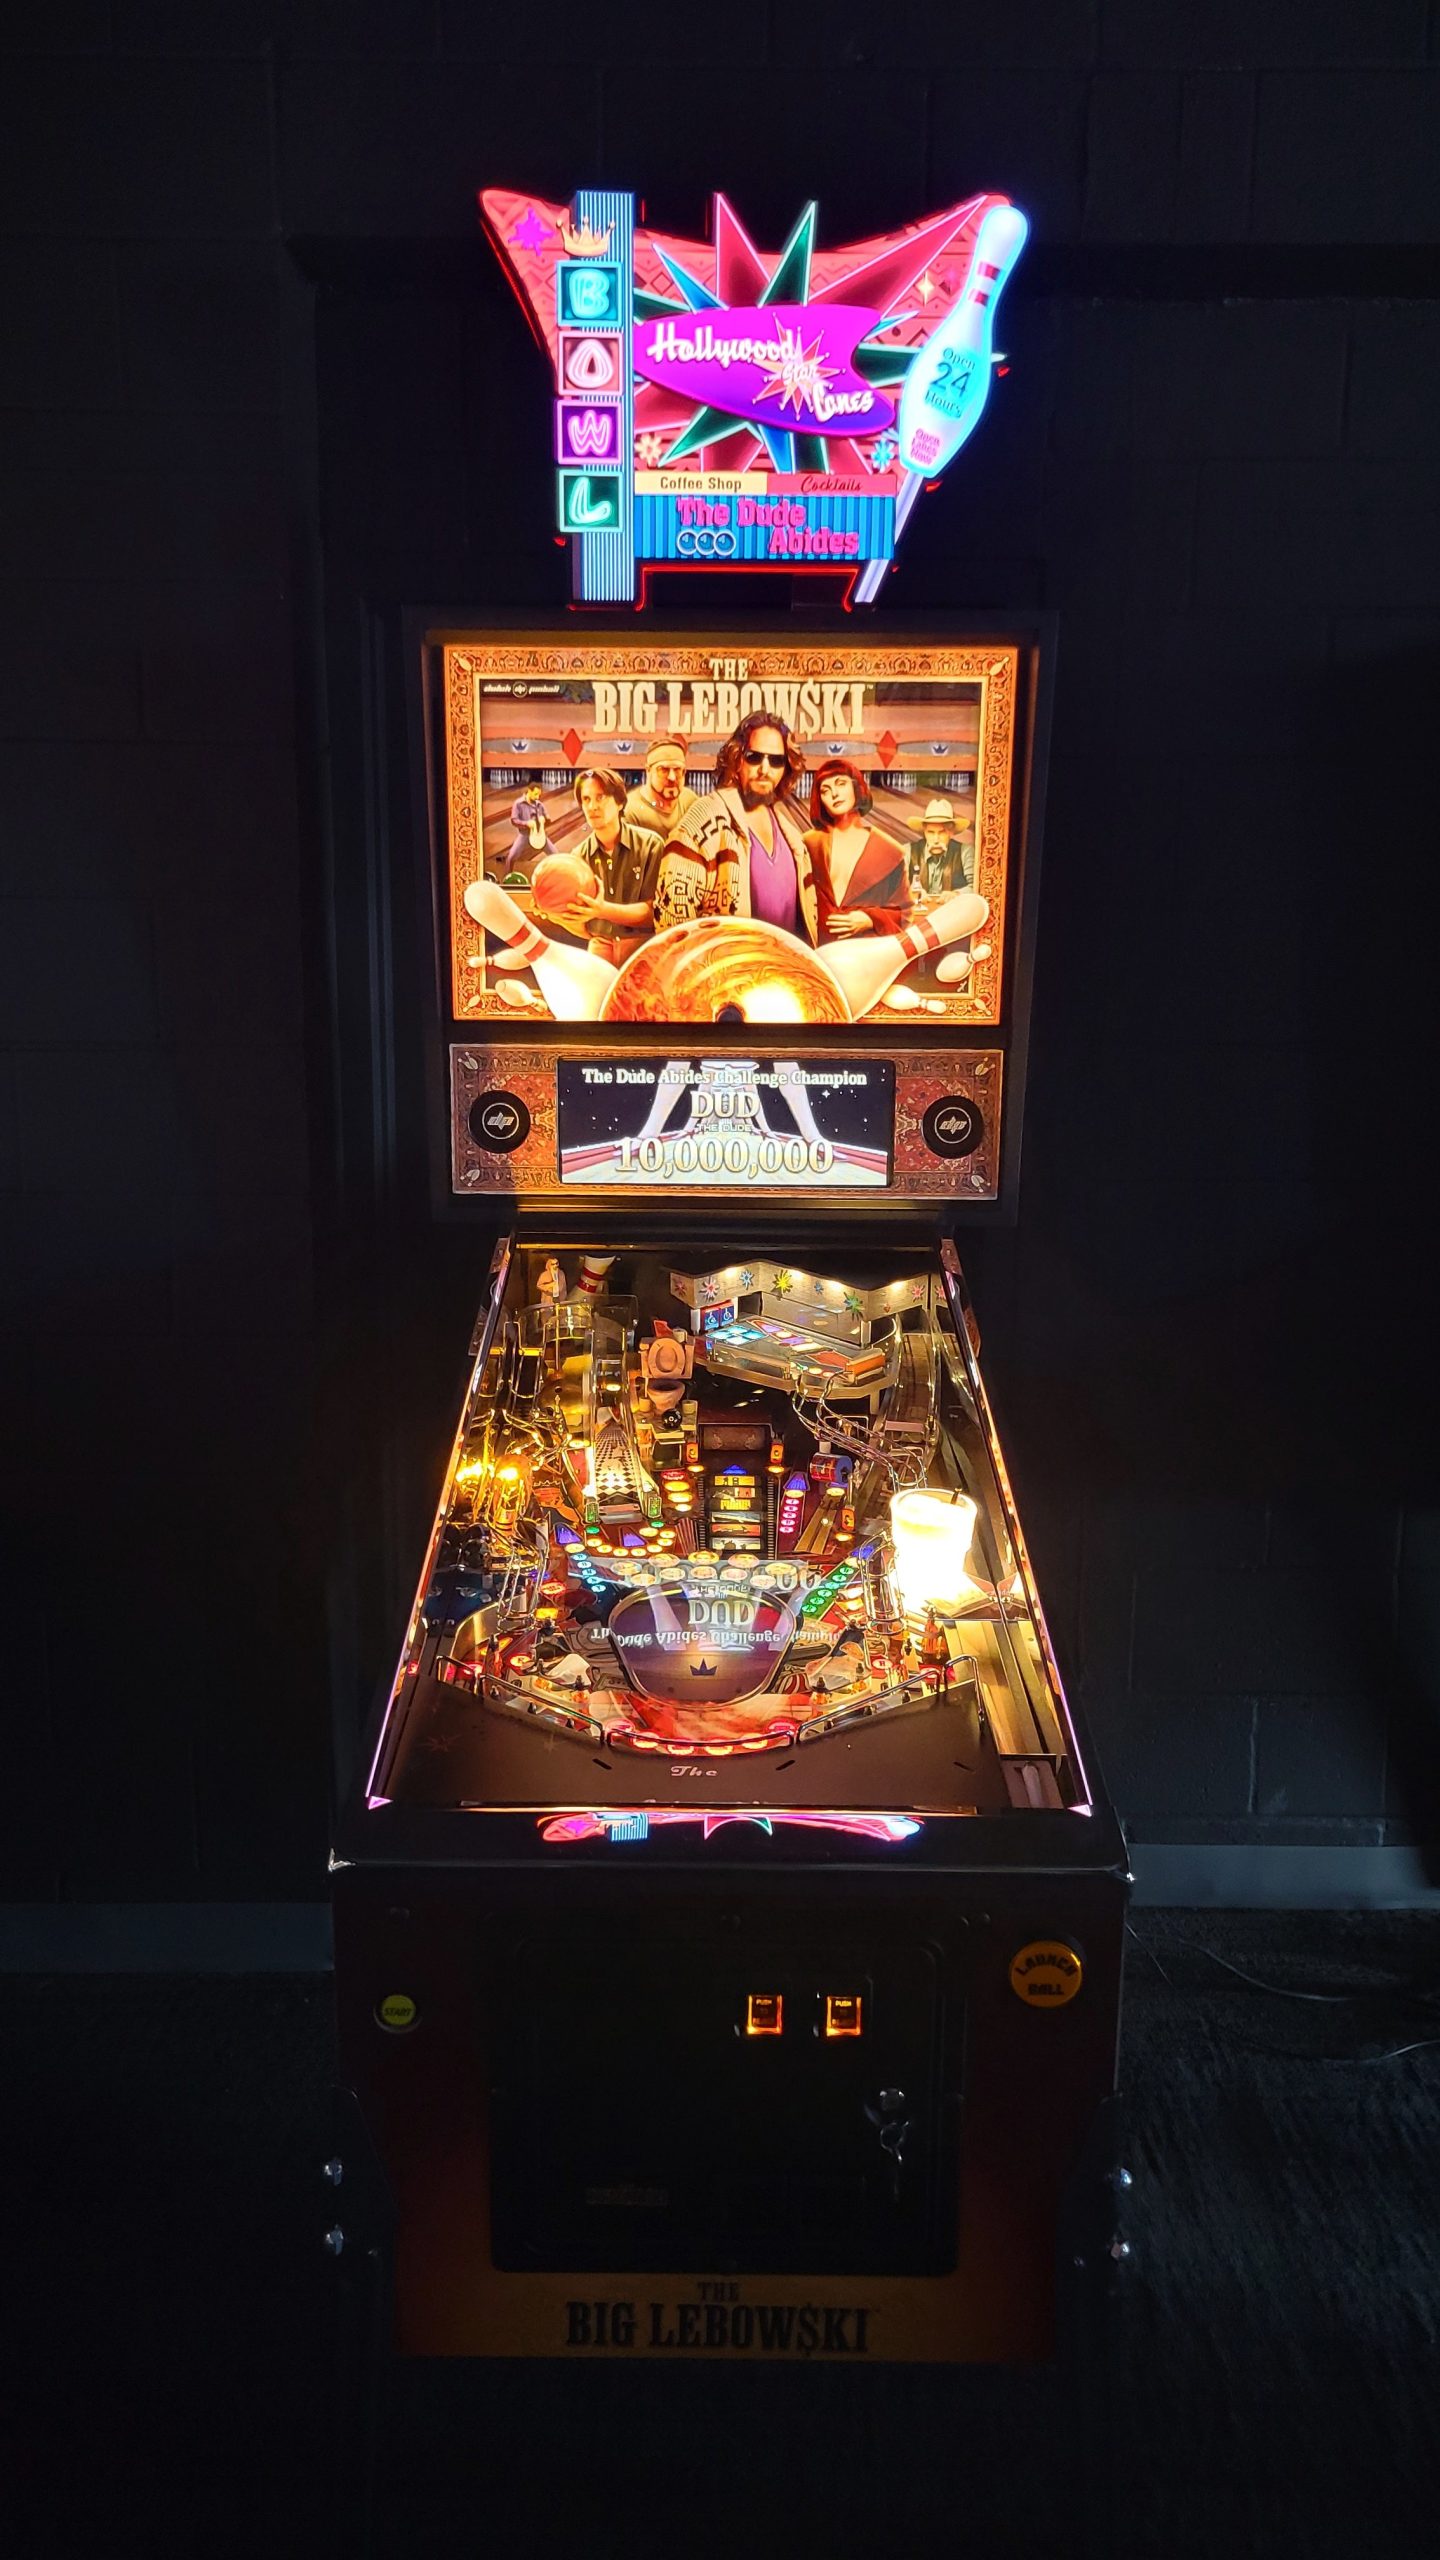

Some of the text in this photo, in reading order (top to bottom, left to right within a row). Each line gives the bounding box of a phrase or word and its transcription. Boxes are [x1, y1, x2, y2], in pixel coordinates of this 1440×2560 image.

[646, 321, 799, 368] Hollywood
[942, 347, 976, 370] Open
[930, 361, 972, 398] 24
[924, 389, 962, 419] Hours
[659, 476, 742, 492] Coffee Shop
[800, 474, 863, 493] Cocktails
[676, 495, 807, 528] The Dude
[767, 525, 860, 555] Abides
[708, 658, 749, 682] THE
[592, 681, 658, 734] BIG
[581, 1067, 868, 1087] The Dude Abides Challenge Champion
[689, 1090, 761, 1119] DUD
[613, 1136, 835, 1179] 10,000,000
[670, 1765, 719, 1777] The
[697, 2281, 740, 2302] THE
[565, 2301, 638, 2348] BIG
